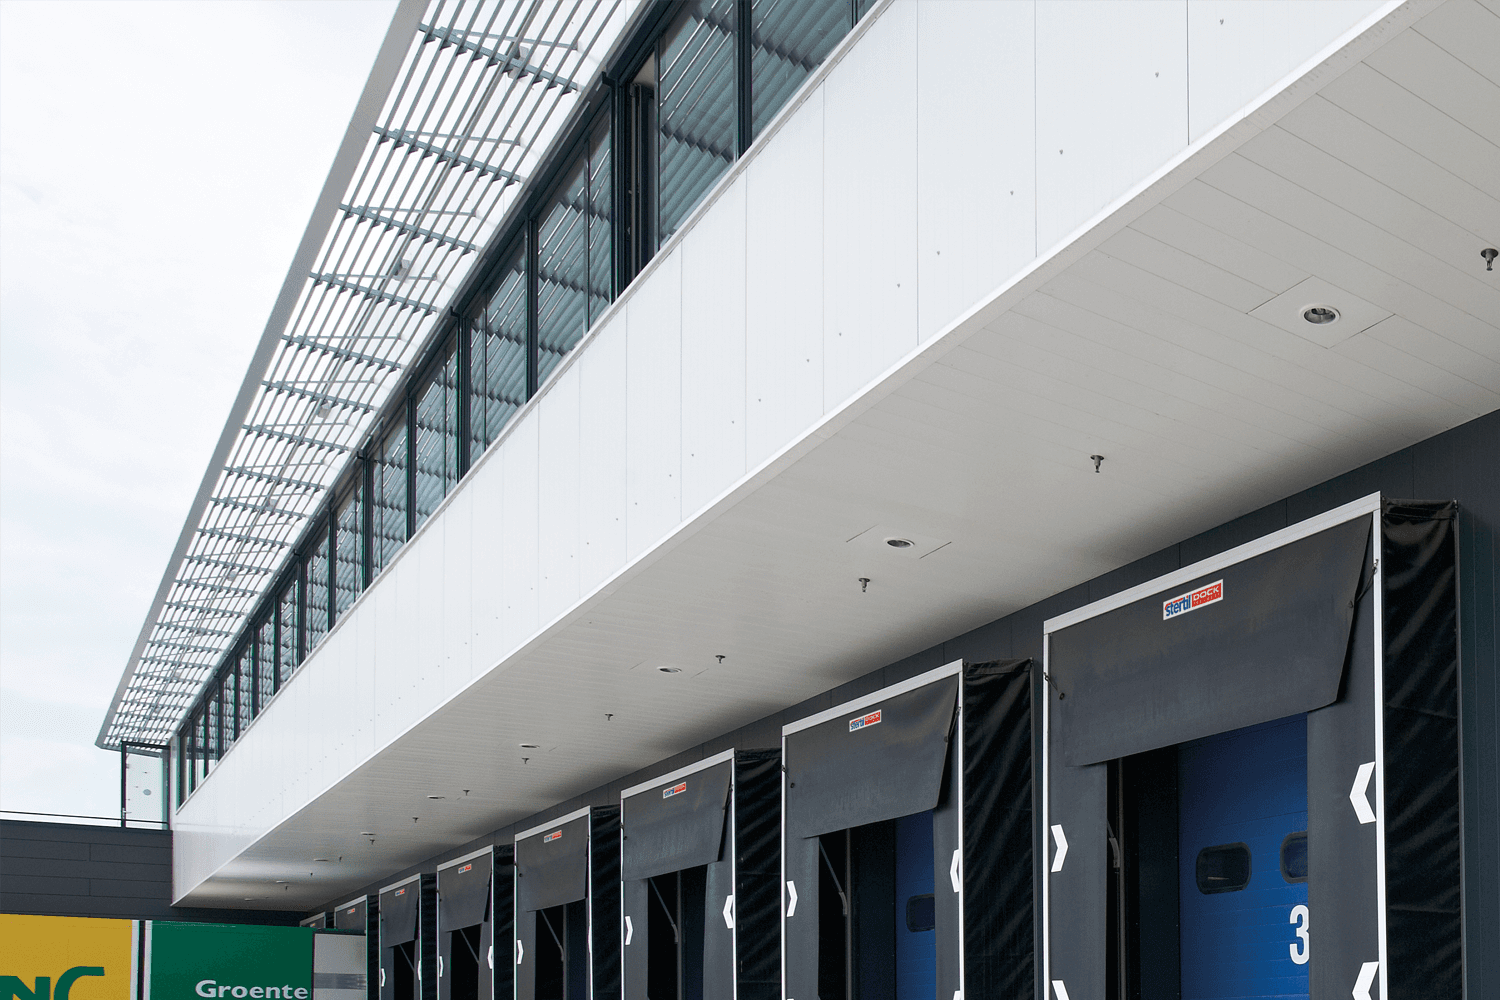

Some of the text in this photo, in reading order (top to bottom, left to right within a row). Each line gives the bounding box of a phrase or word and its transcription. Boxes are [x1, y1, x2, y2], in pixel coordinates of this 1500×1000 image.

[1193, 585, 1220, 601] DOCK
[1289, 904, 1310, 965] 3
[195, 979, 311, 1000] Groente
